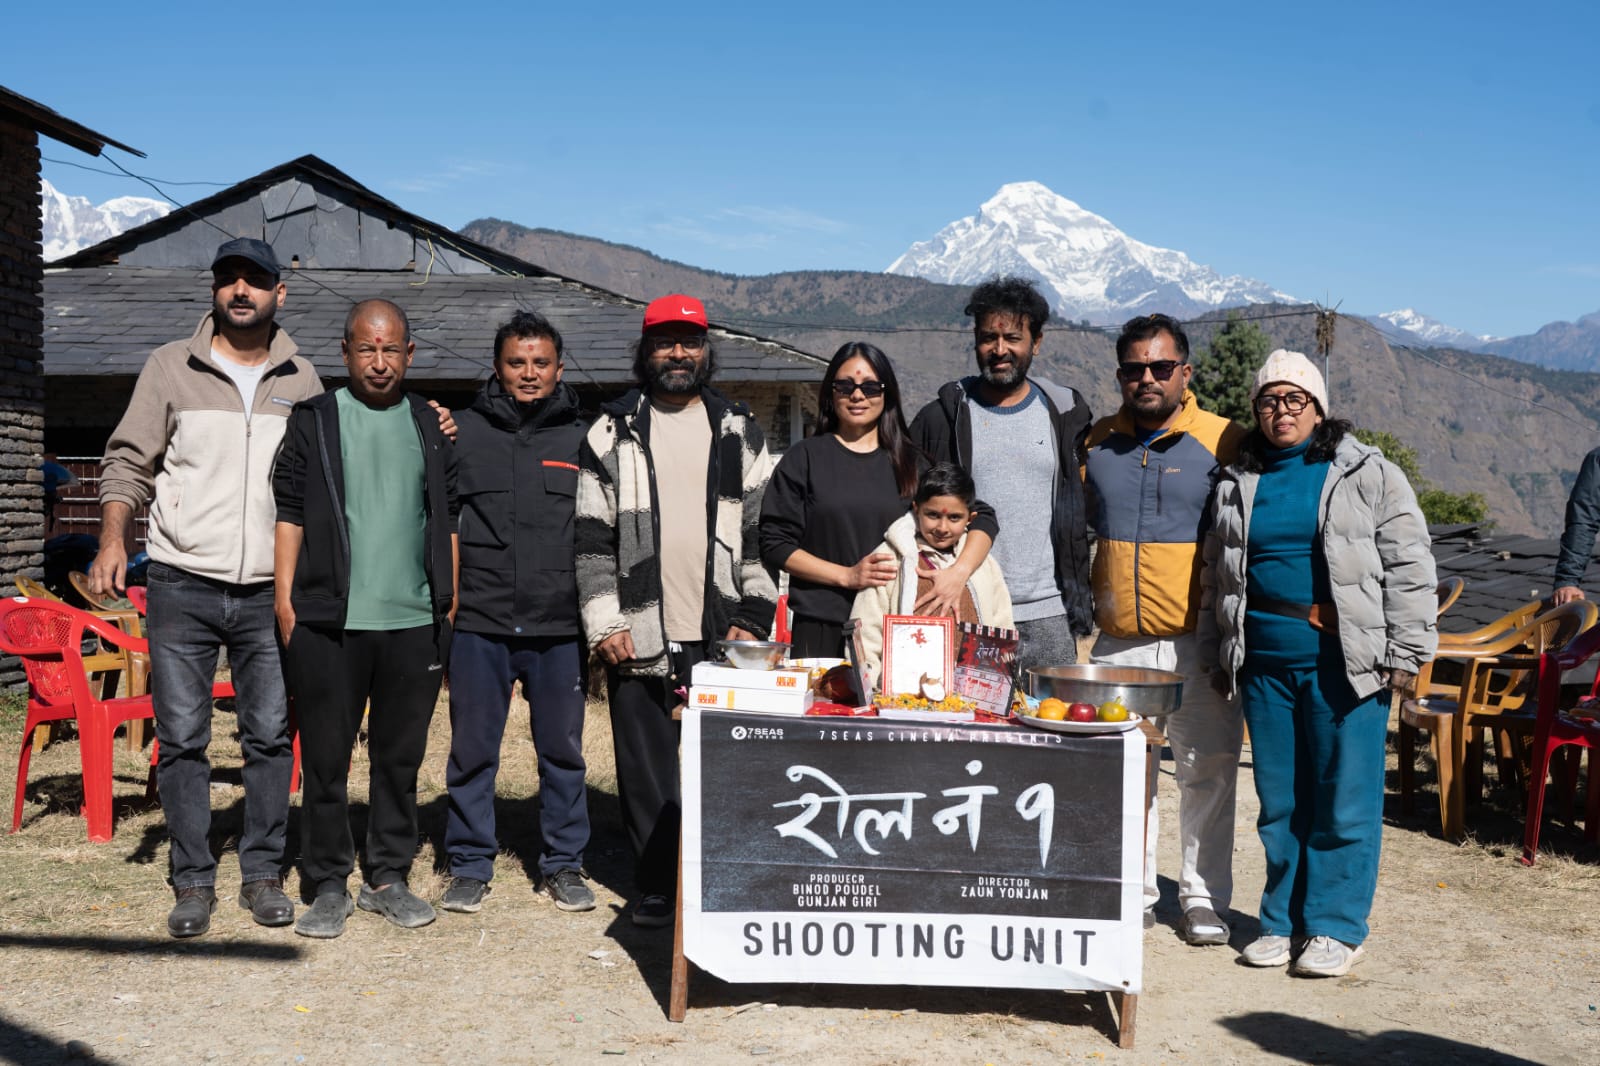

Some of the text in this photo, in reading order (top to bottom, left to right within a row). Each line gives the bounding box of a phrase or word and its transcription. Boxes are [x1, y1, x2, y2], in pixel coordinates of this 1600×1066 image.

[747, 727, 784, 736] 7SEAS
[819, 730, 873, 742] 7SEAS
[888, 731, 954, 743] CINEMA
[773, 765, 927, 859] रोल
[932, 760, 999, 852] नं
[810, 873, 865, 884] PRODUECR
[978, 876, 1031, 887] DIRECTOR
[792, 883, 882, 896] BINOD POUDEL
[961, 886, 1049, 901] ZAUN YONJAN
[797, 895, 878, 908] GUNJAN GIRI
[743, 921, 1096, 967] SHOOTING UNIT
